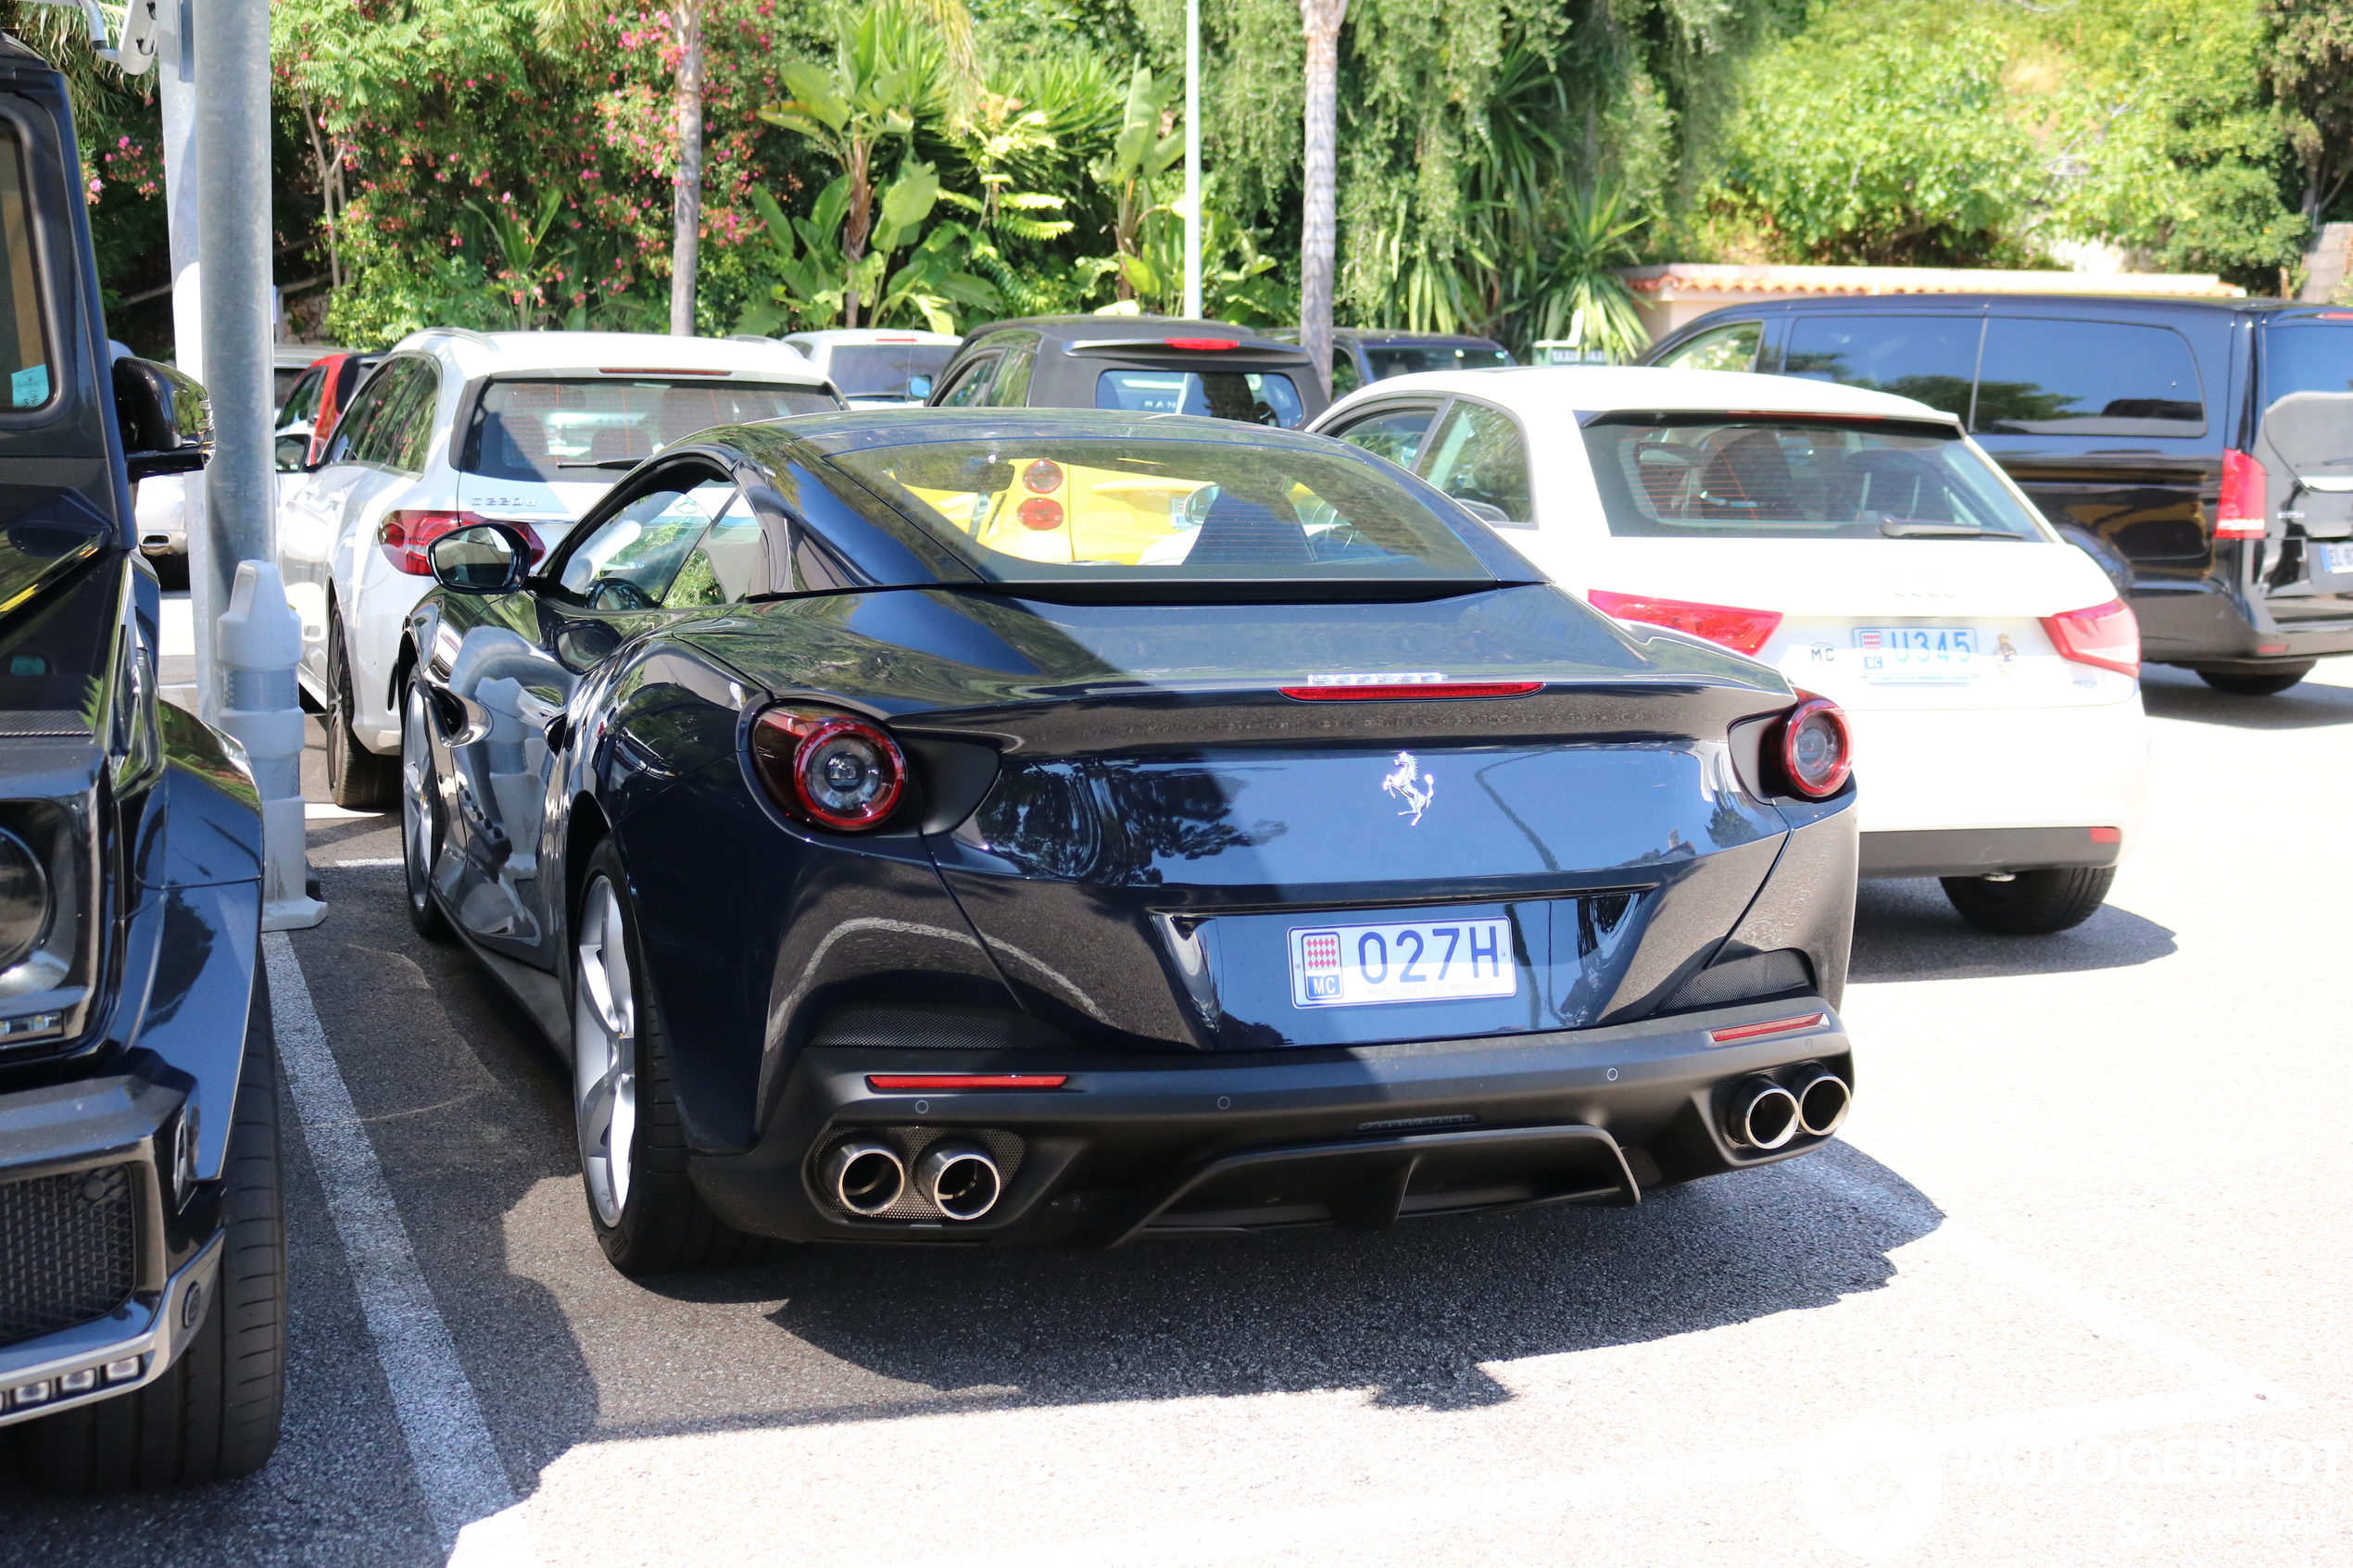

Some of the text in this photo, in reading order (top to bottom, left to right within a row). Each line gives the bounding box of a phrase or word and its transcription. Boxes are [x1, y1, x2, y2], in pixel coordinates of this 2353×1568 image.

[1811, 648, 1835, 662] MC
[1891, 632, 1970, 663] U345
[1358, 926, 1500, 985] 027H
[1313, 977, 1337, 995] MC
[1435, 984, 1447, 993] DE
[1451, 982, 1492, 992] MONACO
